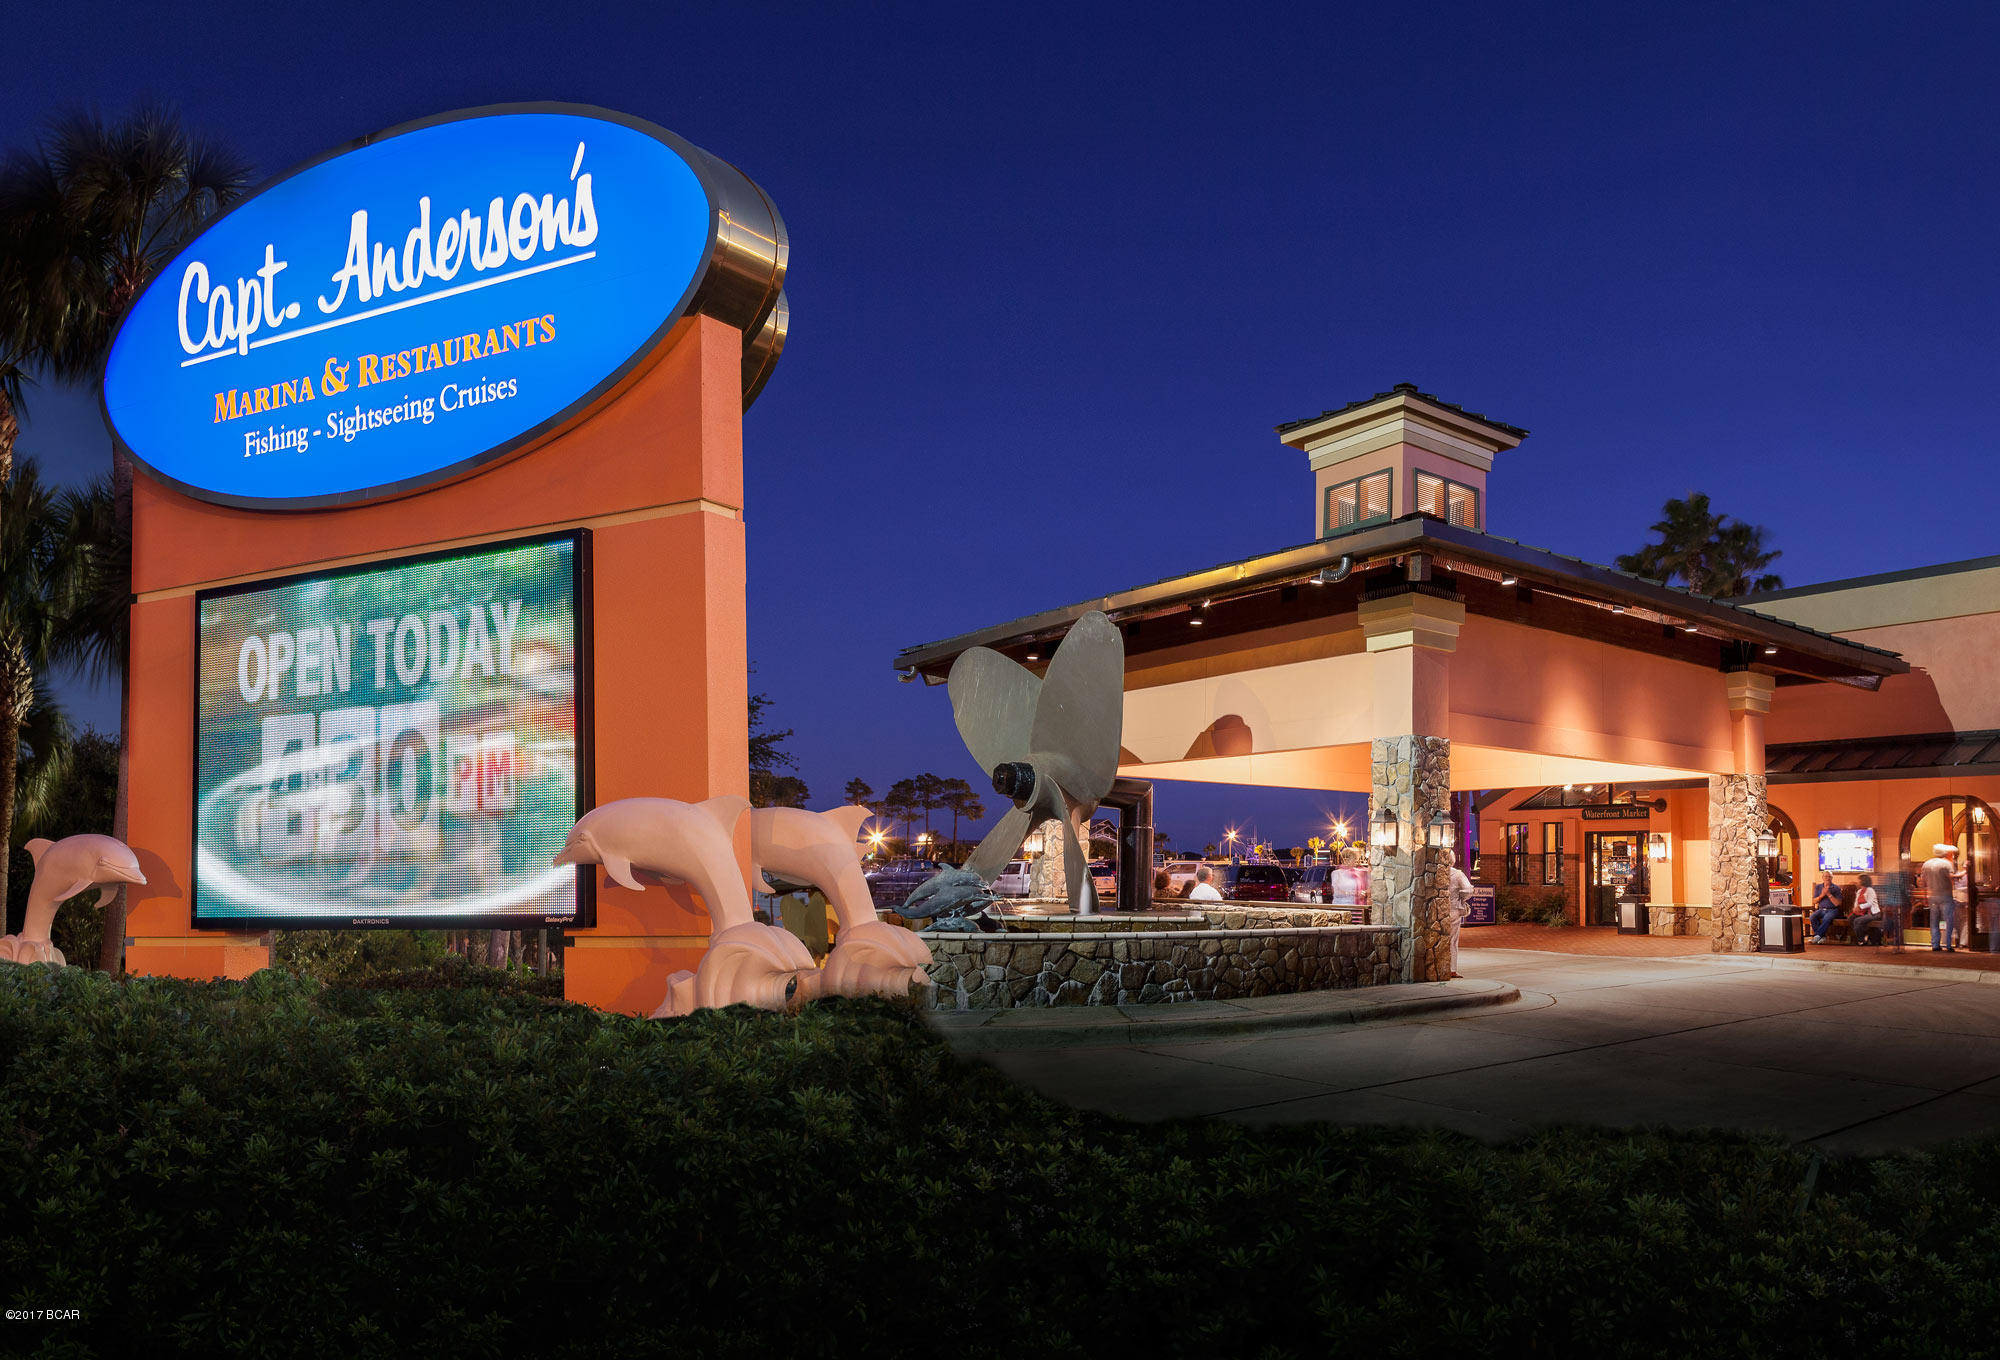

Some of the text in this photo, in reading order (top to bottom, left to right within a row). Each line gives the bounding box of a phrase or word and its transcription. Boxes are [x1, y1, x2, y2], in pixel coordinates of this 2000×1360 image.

[178, 142, 599, 356] Capt. Anderson's
[213, 314, 556, 424] MARINA & RESTAURANTS
[243, 424, 309, 458] Fishing
[326, 397, 435, 443] Sightseeing
[439, 378, 518, 412] Cruises
[238, 600, 522, 703] OPEN TODAY
[1585, 808, 1647, 818] Waterfront Market
